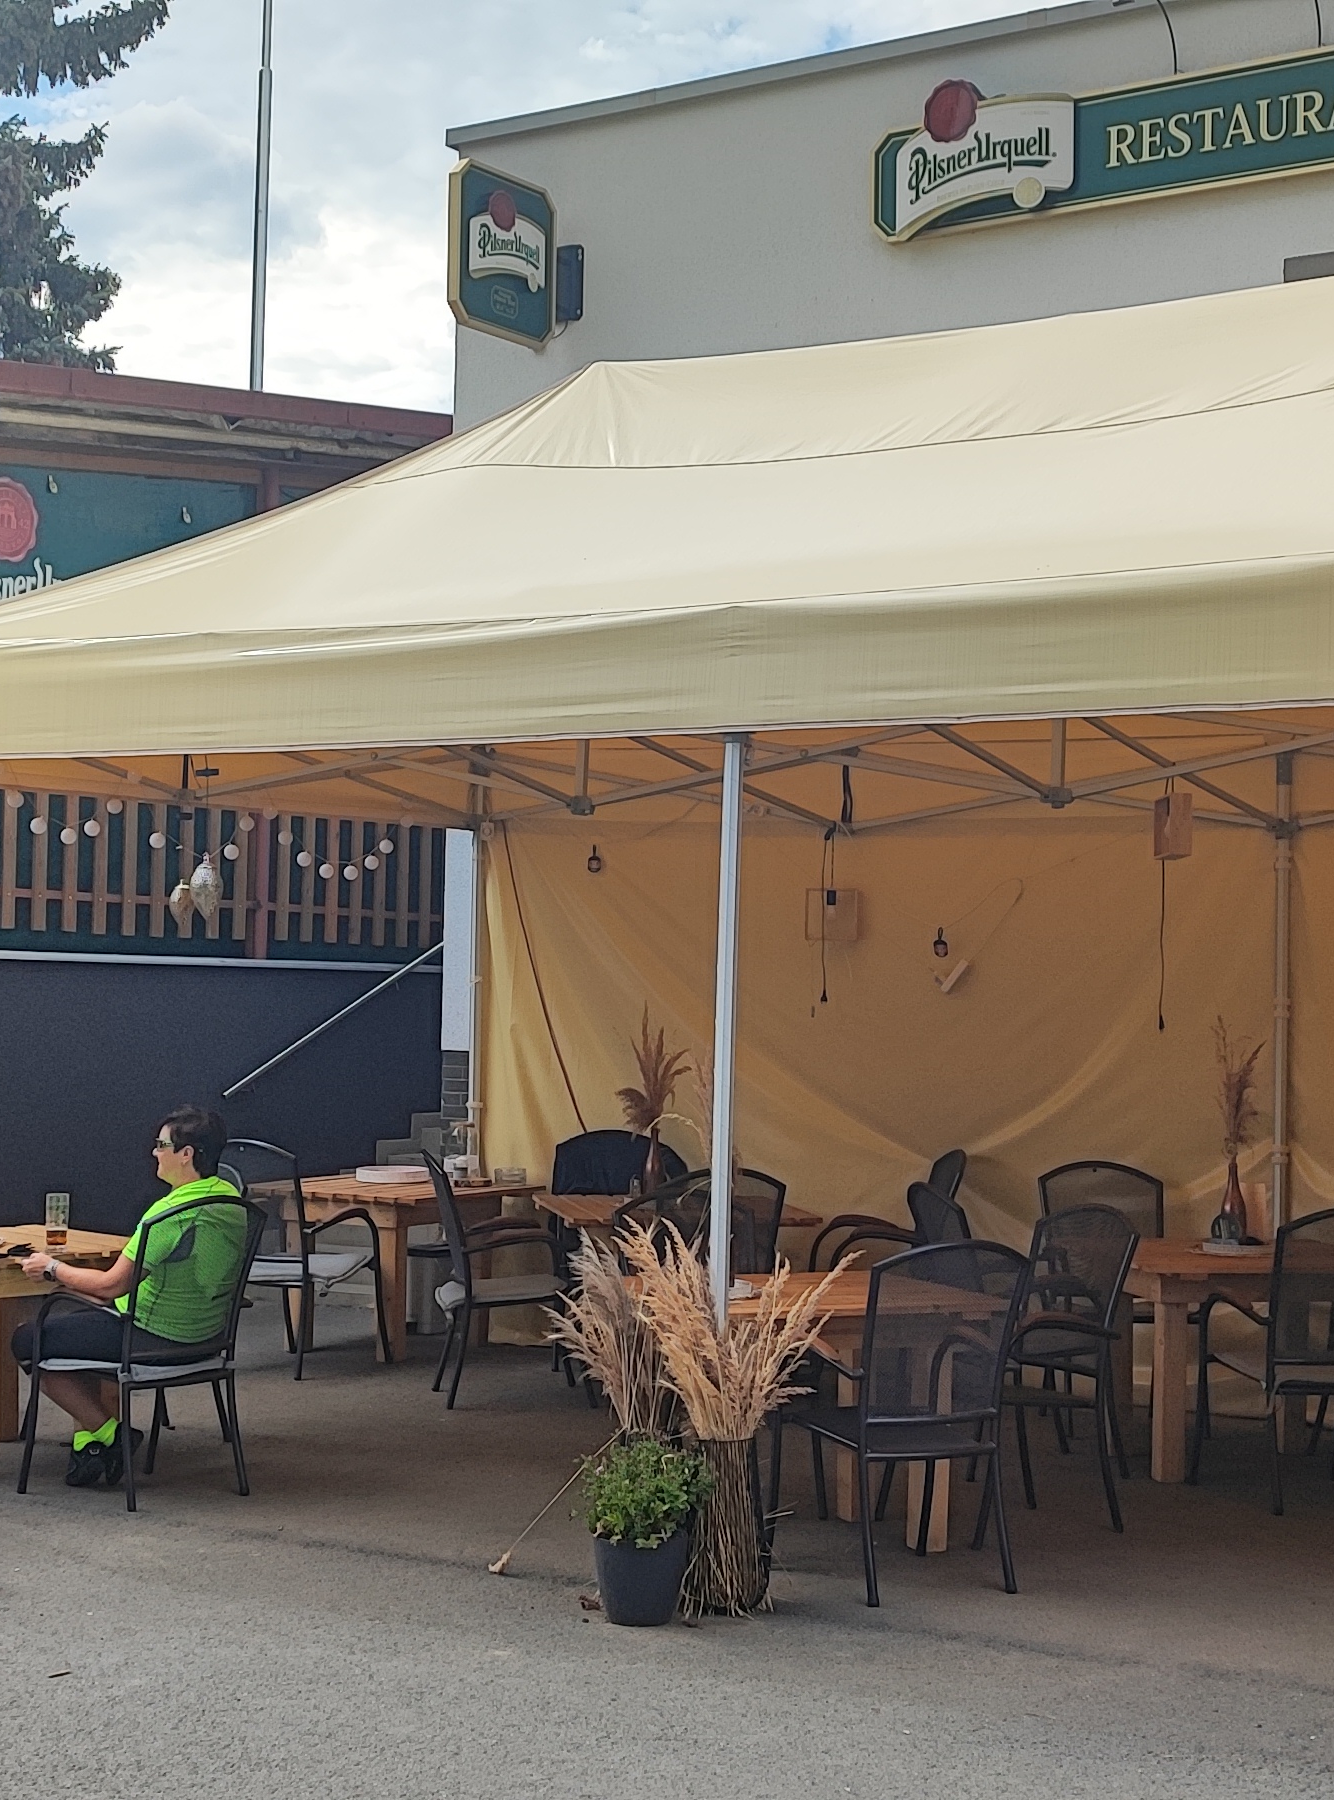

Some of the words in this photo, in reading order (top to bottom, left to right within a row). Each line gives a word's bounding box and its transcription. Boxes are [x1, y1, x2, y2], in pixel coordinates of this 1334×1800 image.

[907, 146, 977, 205] Pilsner
[973, 126, 1051, 174] Urquell
[477, 222, 515, 259] Pilsner
